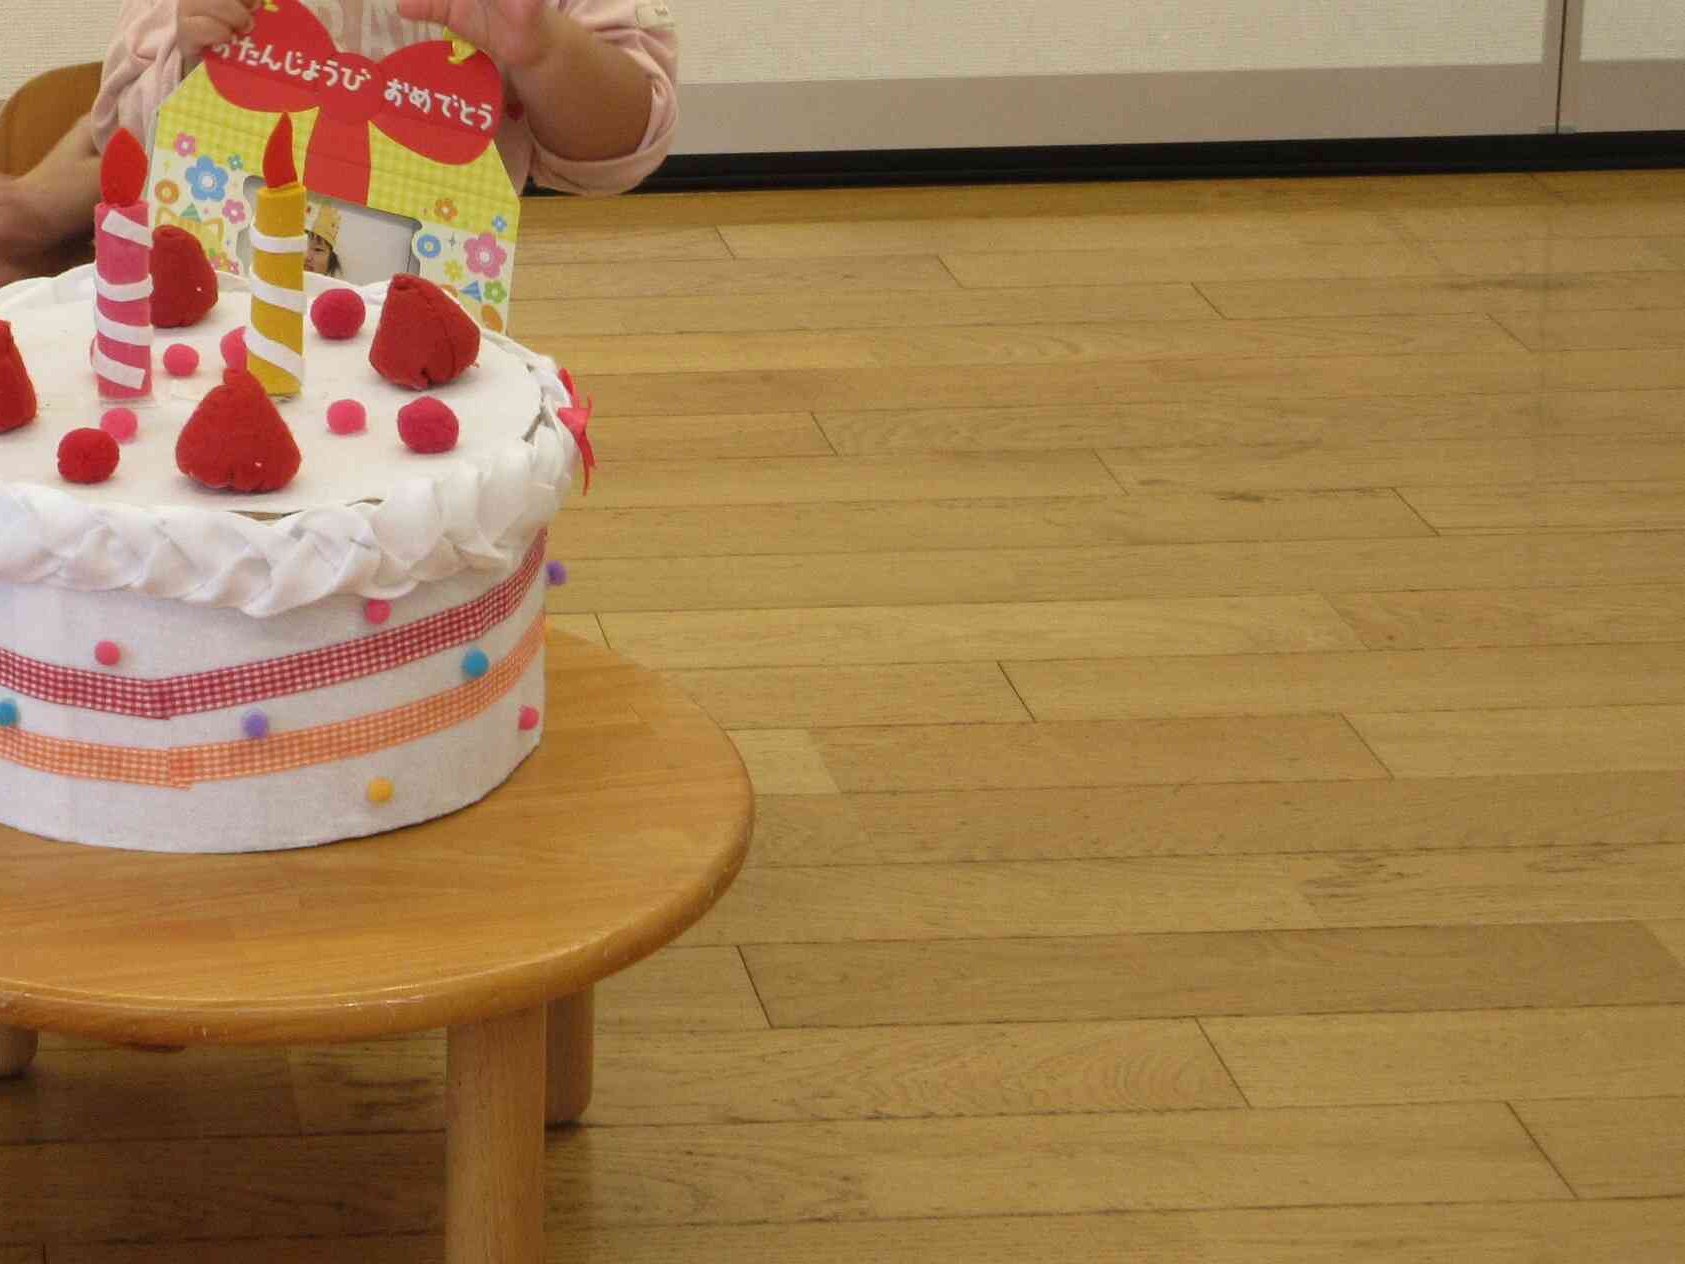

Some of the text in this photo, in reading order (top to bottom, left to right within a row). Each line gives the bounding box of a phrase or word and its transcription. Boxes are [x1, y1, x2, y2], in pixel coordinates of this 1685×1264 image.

[384, 78, 493, 131] おめでとう
